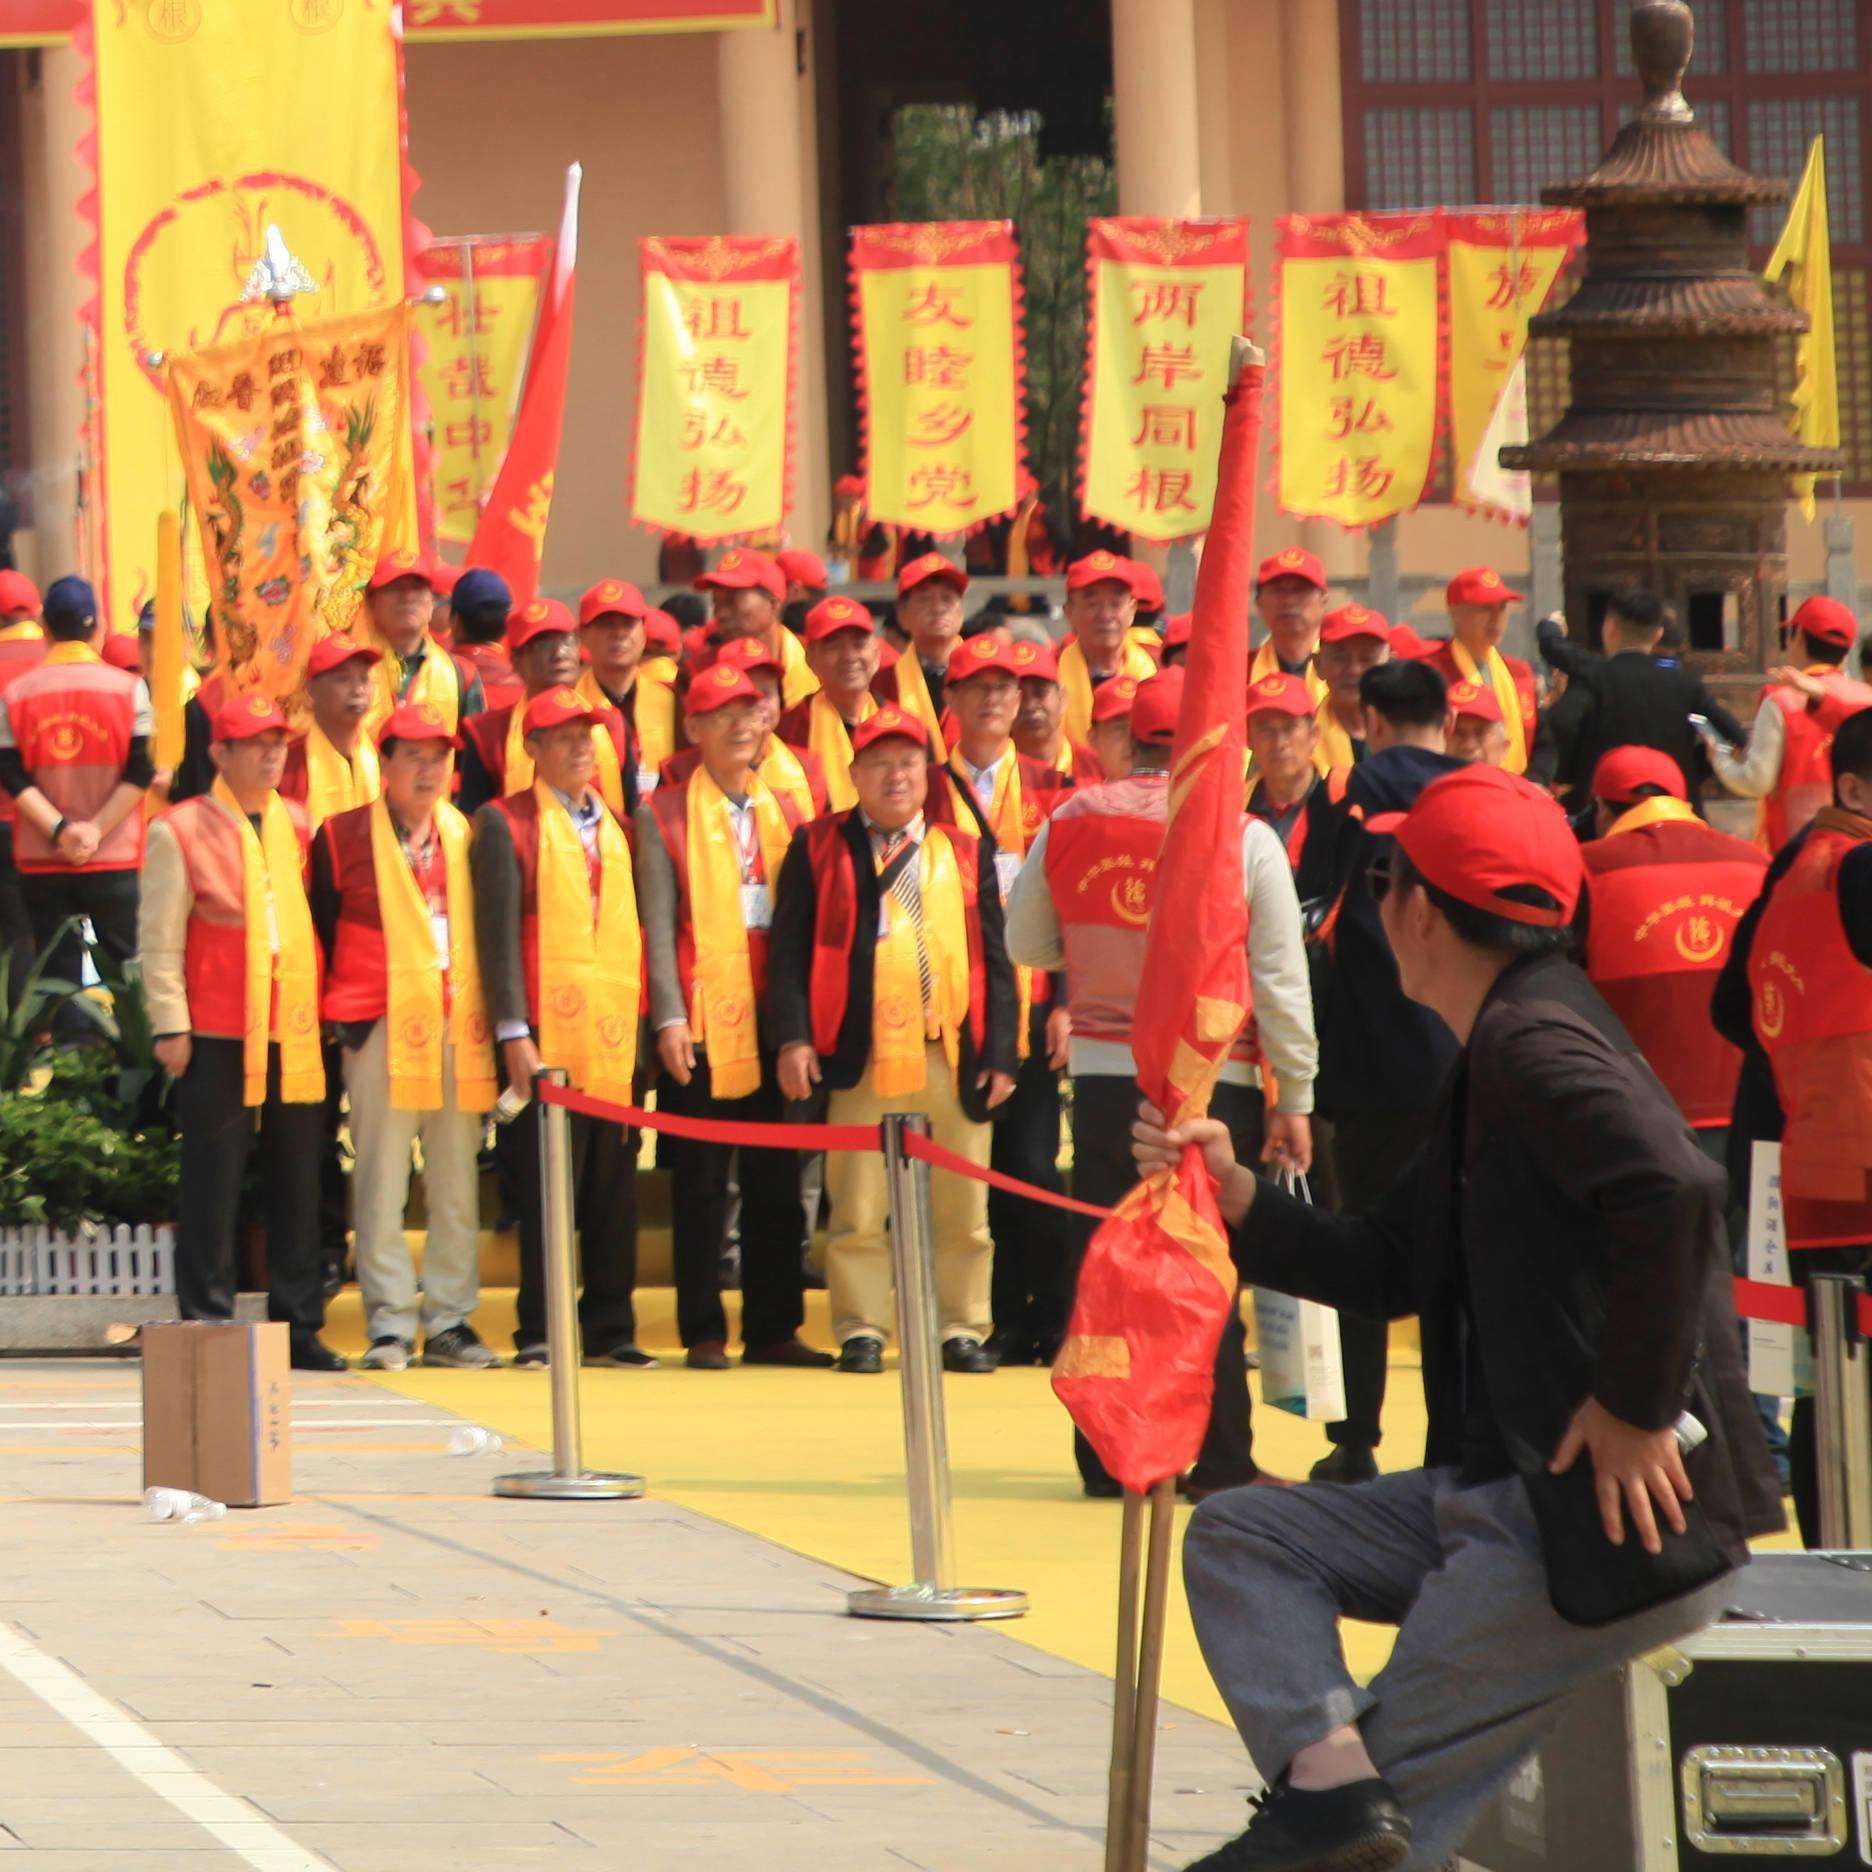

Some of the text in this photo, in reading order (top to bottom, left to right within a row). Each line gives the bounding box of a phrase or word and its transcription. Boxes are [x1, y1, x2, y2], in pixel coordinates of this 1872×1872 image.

[1125, 279, 1205, 512] 两岸同根
[1320, 270, 1400, 502] 祖德弘扬
